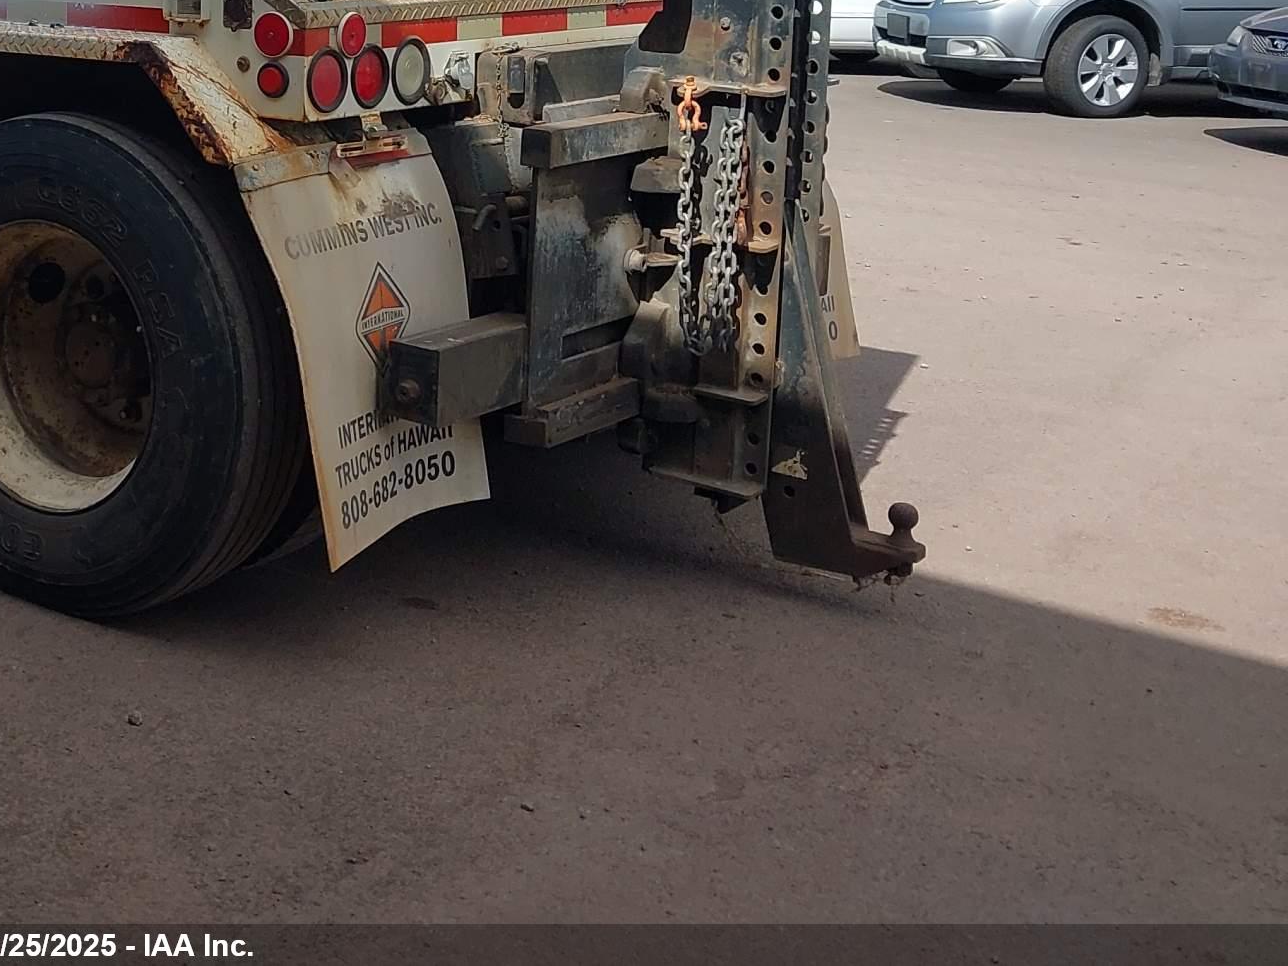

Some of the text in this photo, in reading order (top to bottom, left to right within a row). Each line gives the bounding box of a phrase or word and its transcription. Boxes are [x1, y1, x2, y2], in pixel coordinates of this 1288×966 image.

[284, 202, 443, 260] CUMMINS WEST INC.
[361, 309, 404, 331] INTERNATIONAL
[821, 295, 835, 313] AII
[338, 409, 399, 450] INTER
[335, 444, 382, 489] TRUCKS
[383, 434, 395, 462] of
[341, 450, 456, 530] 808-682-8050
